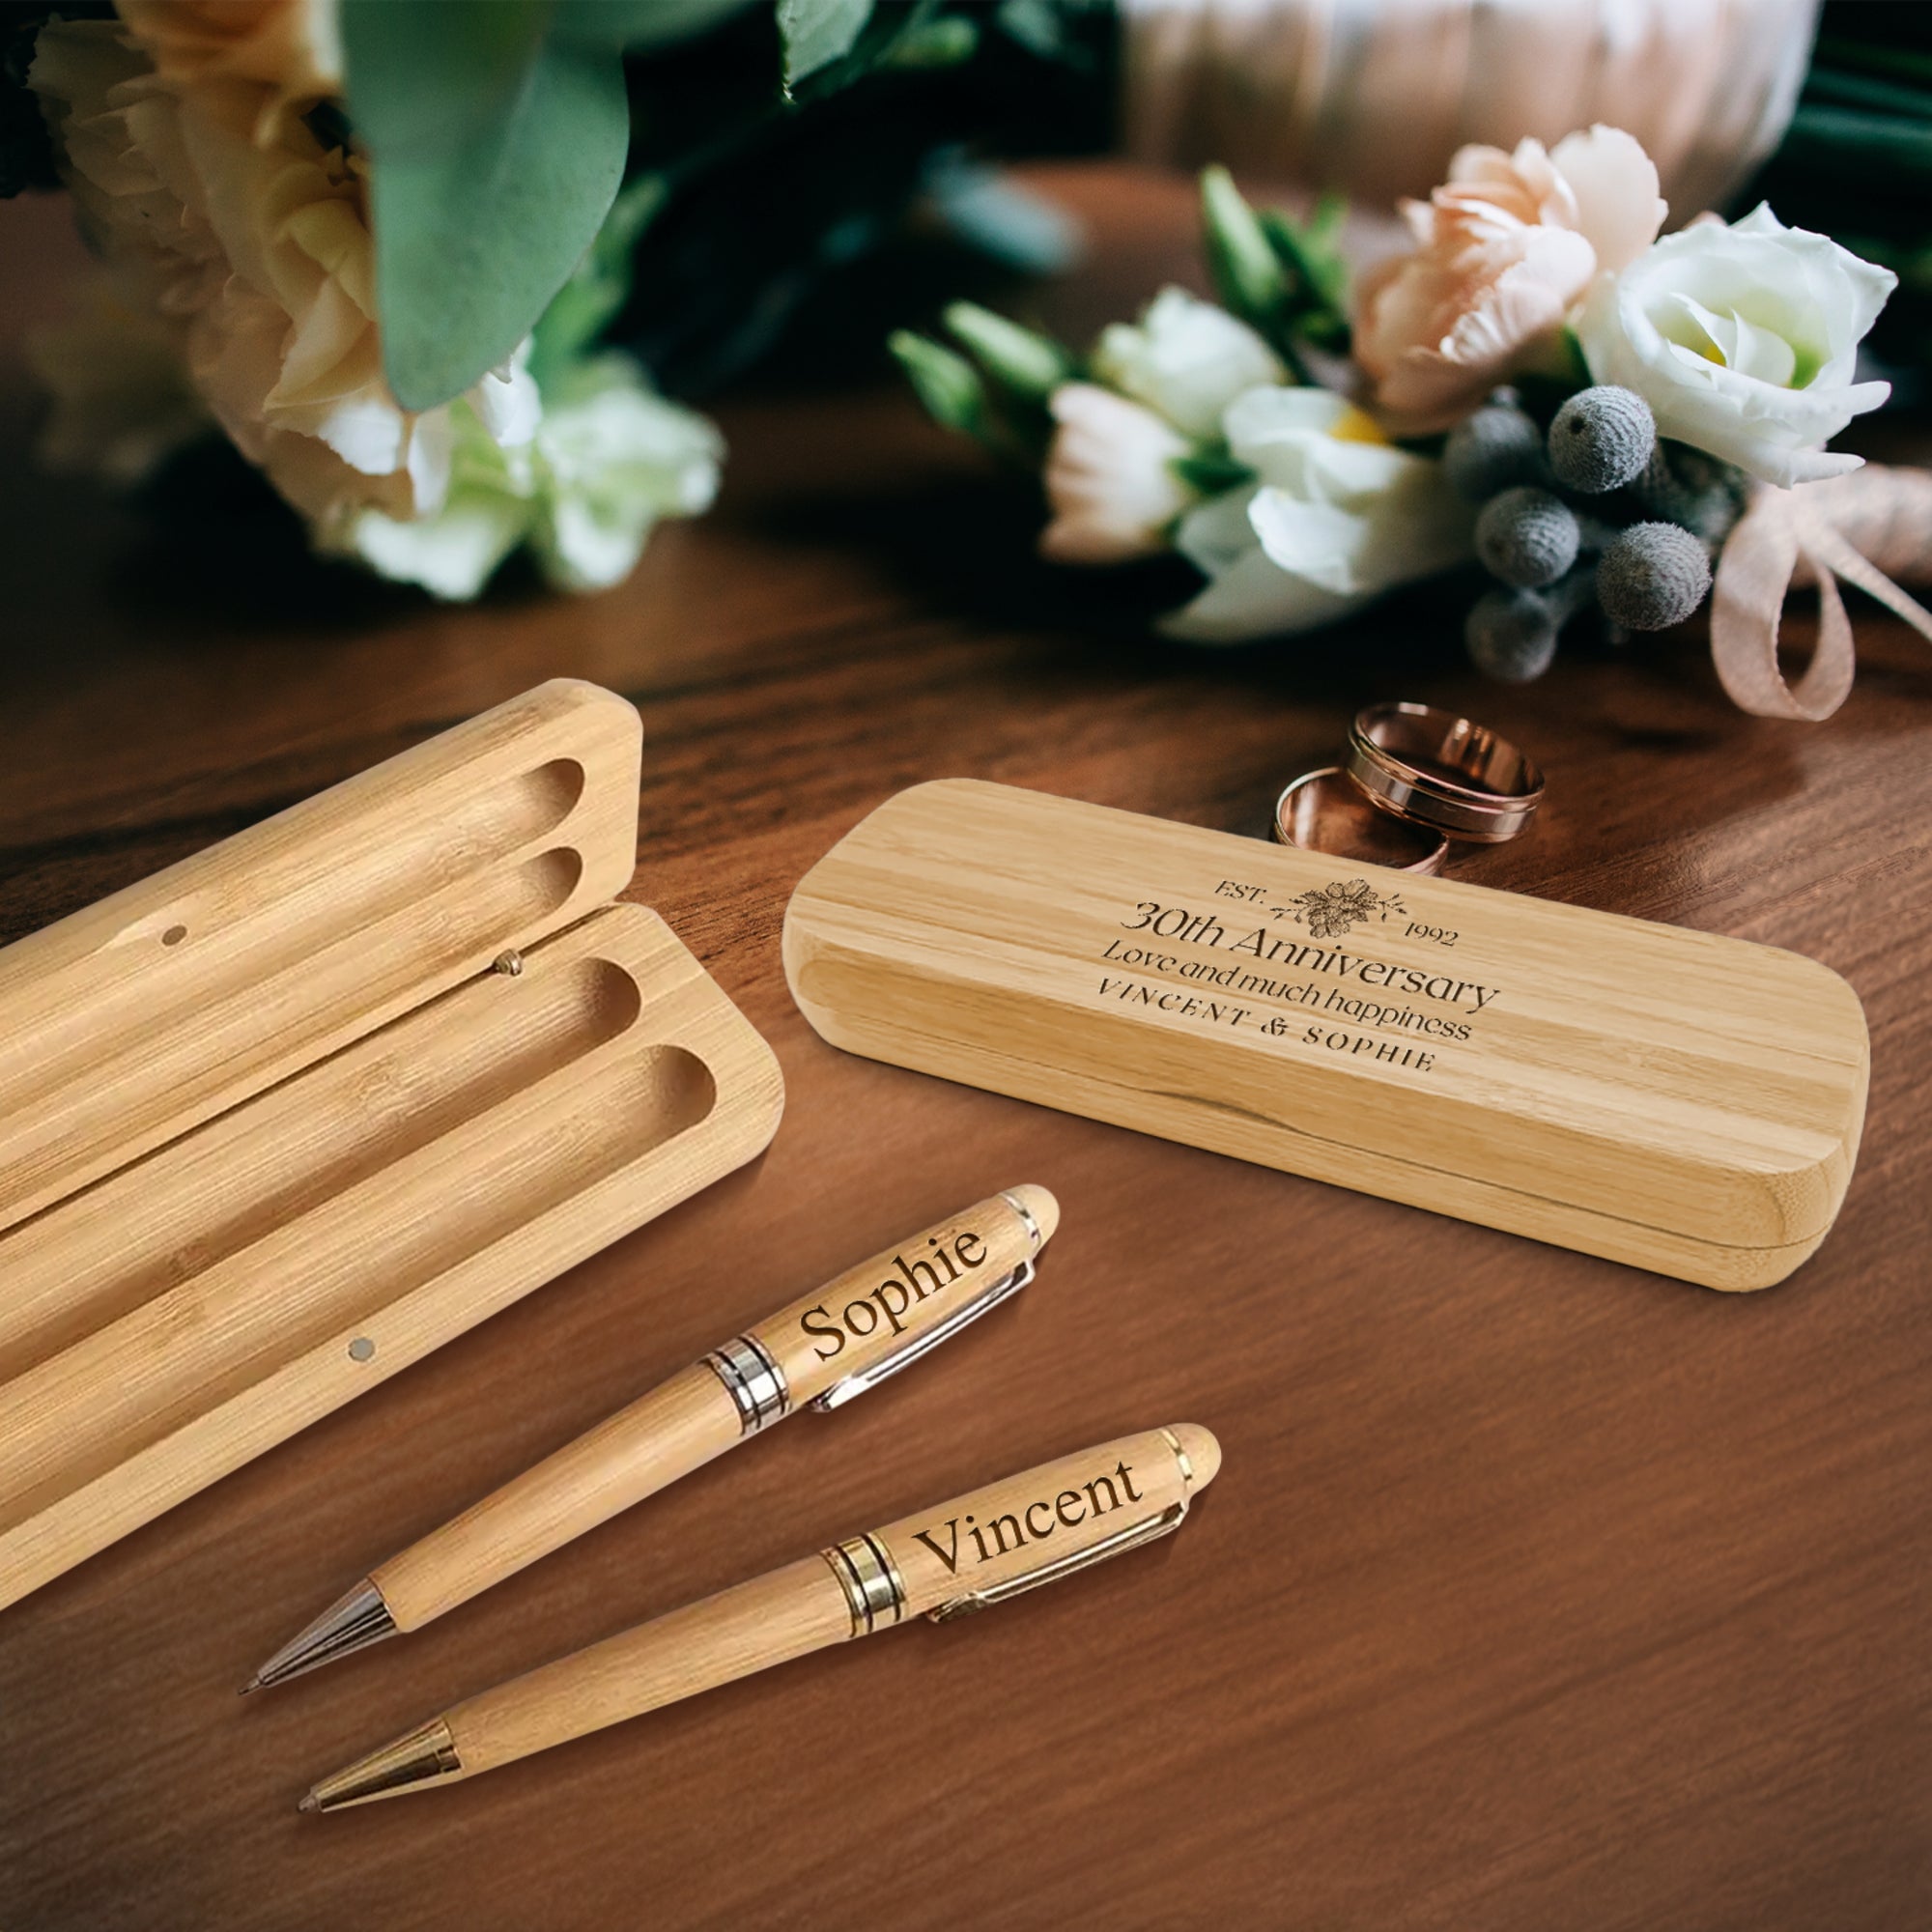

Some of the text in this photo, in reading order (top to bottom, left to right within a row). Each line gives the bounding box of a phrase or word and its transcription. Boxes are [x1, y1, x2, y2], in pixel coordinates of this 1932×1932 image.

[1121, 902, 1500, 1014] 30th Anniversary
[1214, 880, 1460, 947] EST. 1992
[1097, 978, 1436, 1072] VINCENT & SOPHIE
[1101, 939, 1472, 1040] Love and much happiness
[799, 1232, 987, 1362] Sophie
[911, 1461, 1144, 1576] Vincent
